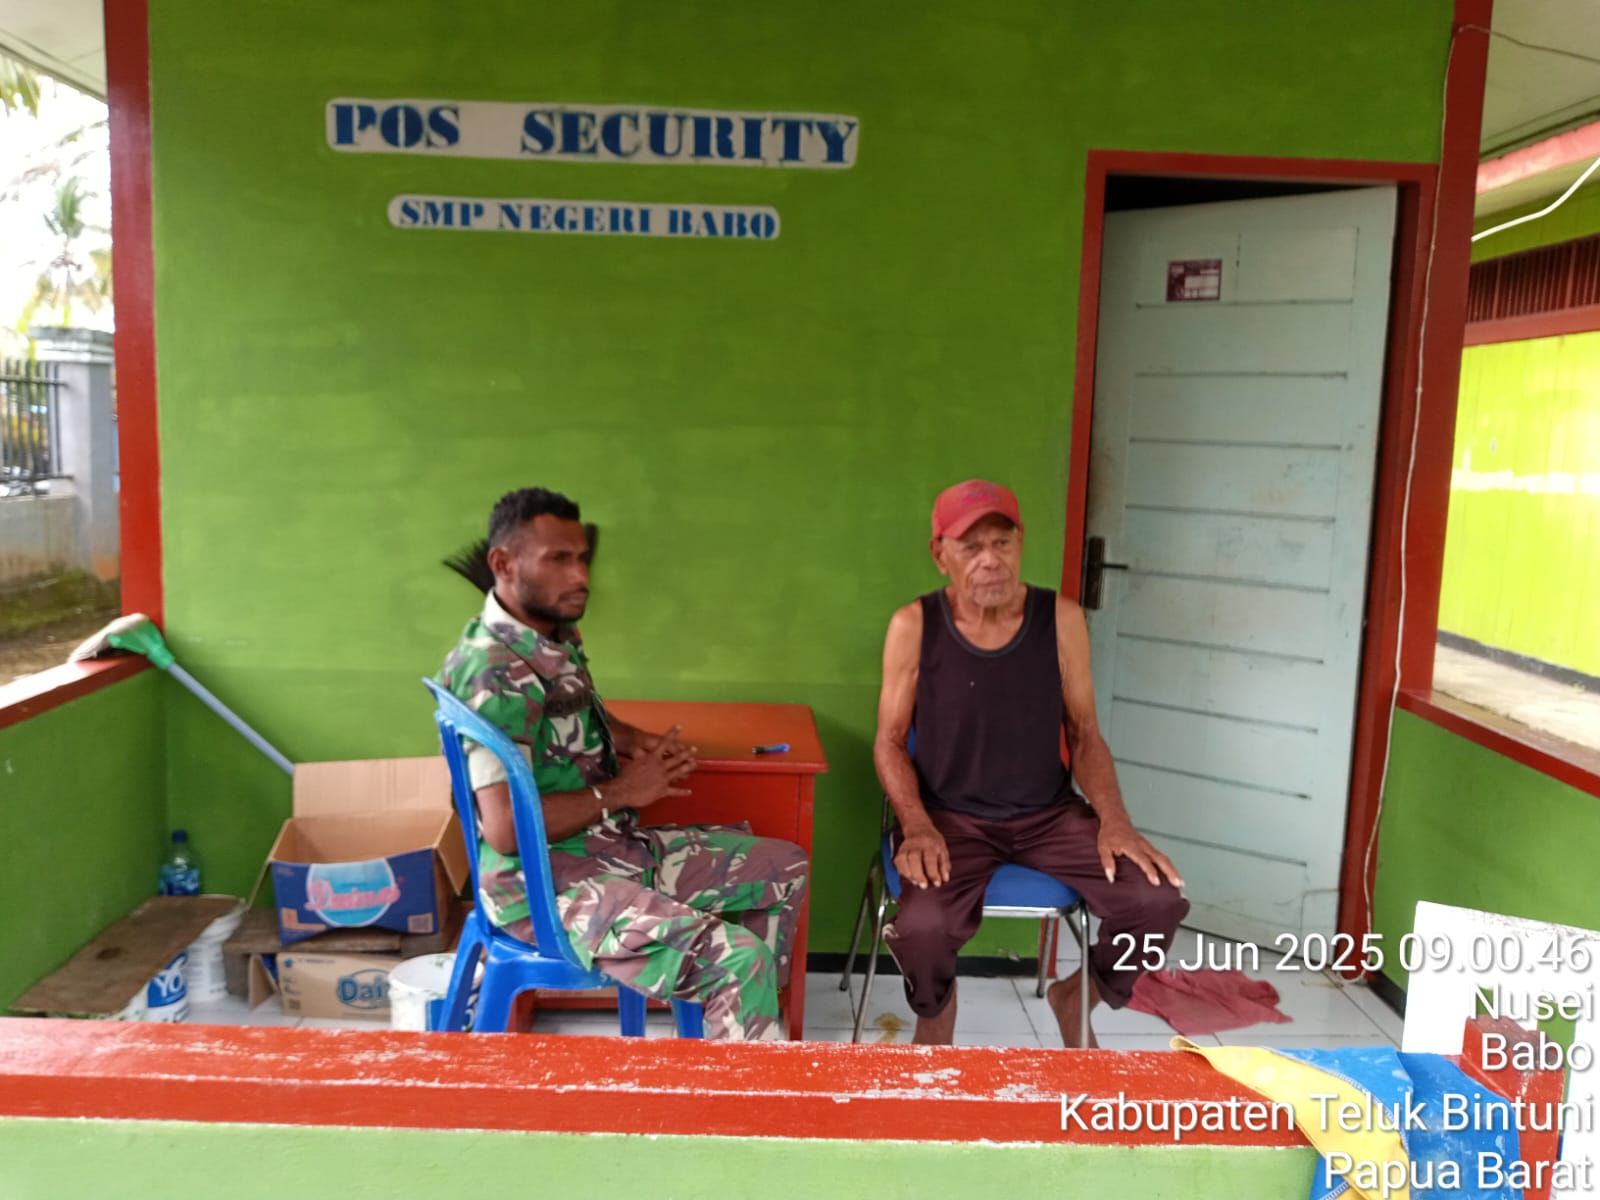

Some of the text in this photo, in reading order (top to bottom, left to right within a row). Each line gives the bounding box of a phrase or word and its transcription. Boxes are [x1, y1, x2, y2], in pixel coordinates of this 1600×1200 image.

[331, 104, 857, 164] POS SECURITY
[401, 200, 776, 239] SMP NEGERI BABO
[338, 976, 391, 1003] Dai
